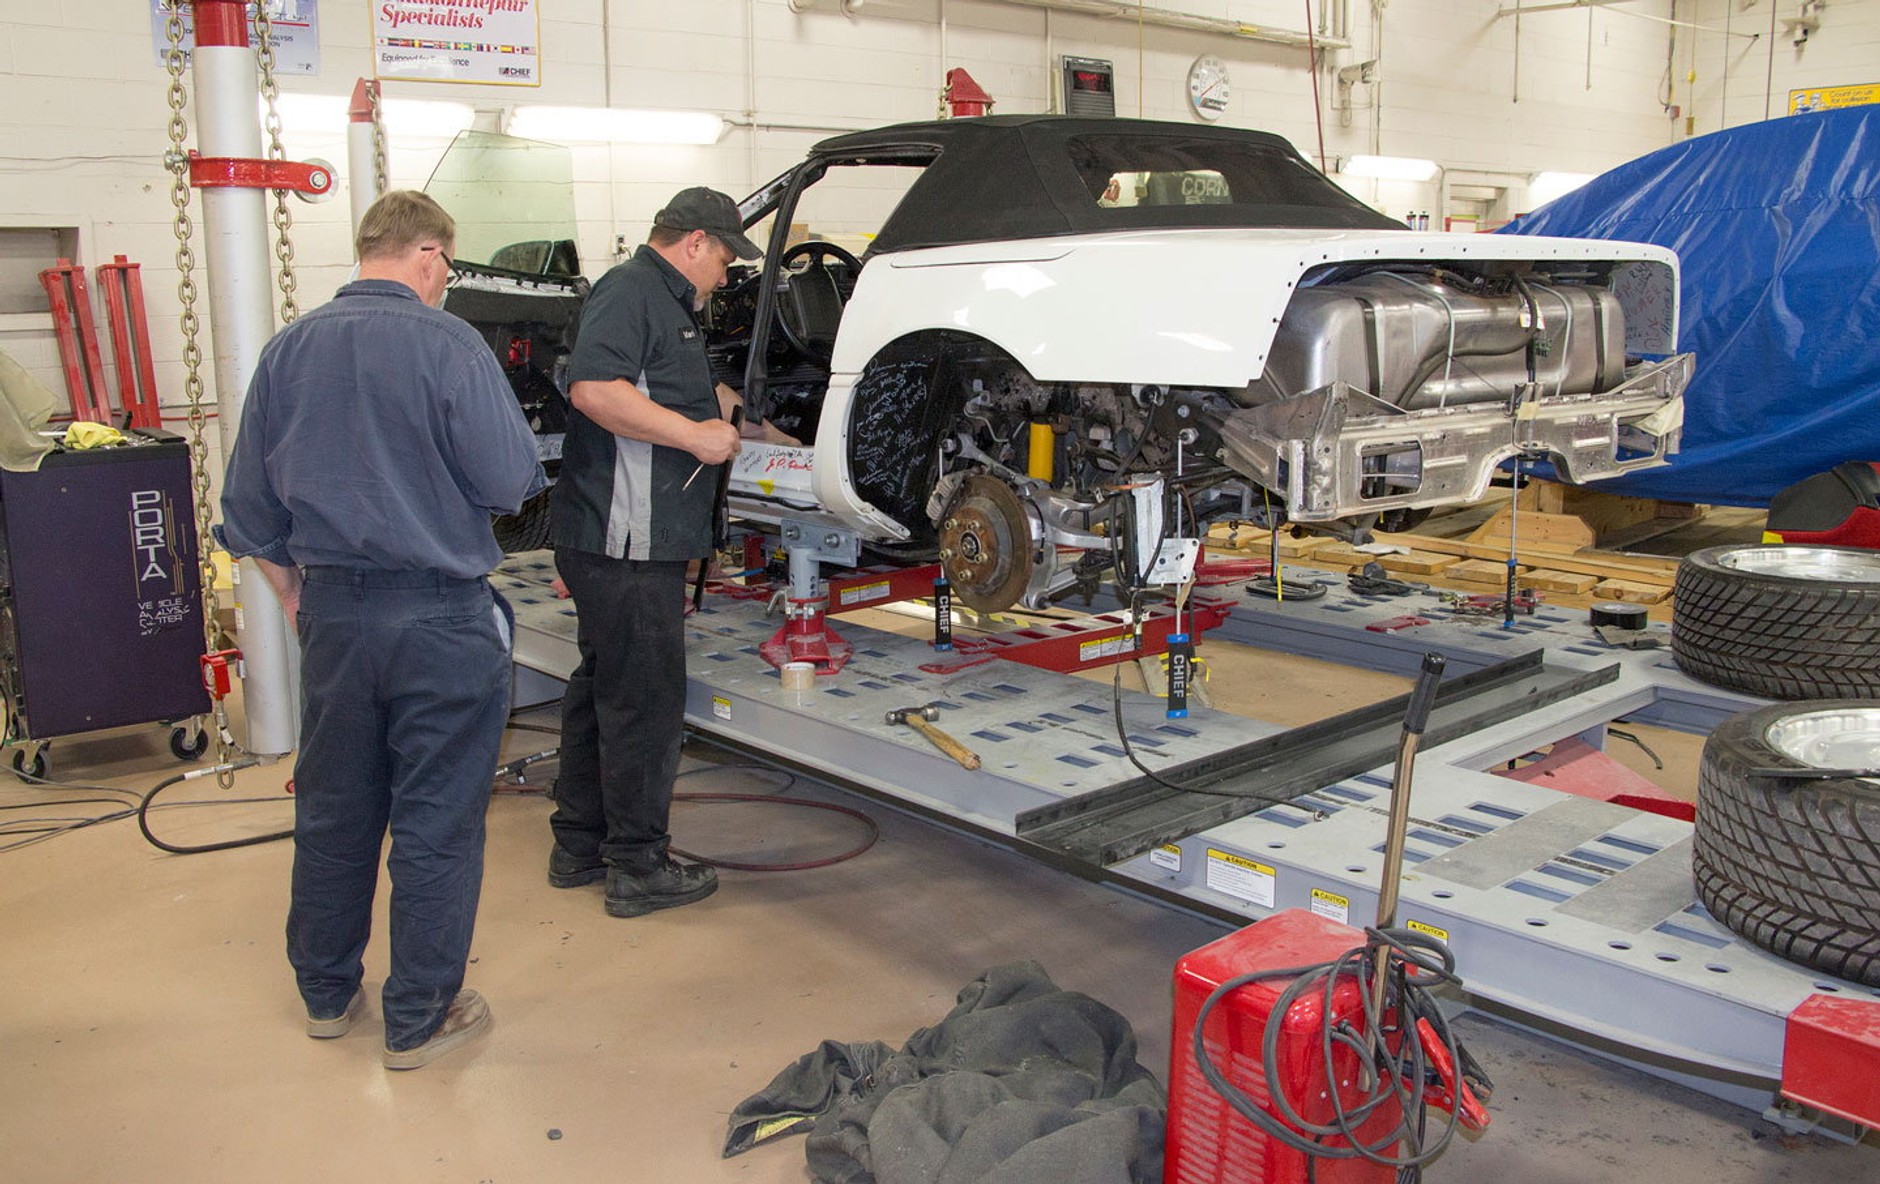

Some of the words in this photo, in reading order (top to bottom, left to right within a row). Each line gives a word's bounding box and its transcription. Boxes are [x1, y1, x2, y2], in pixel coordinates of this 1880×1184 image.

[380, 3, 484, 29] Specialists
[1181, 177, 1230, 197] CORN
[131, 490, 167, 582] PORTA
[939, 594, 950, 635] CHIEF
[1173, 653, 1185, 699] CHIEF
[1231, 856, 1258, 870] CAUTION
[1320, 891, 1347, 906] CAUTION
[1417, 924, 1445, 938] CAUTION
